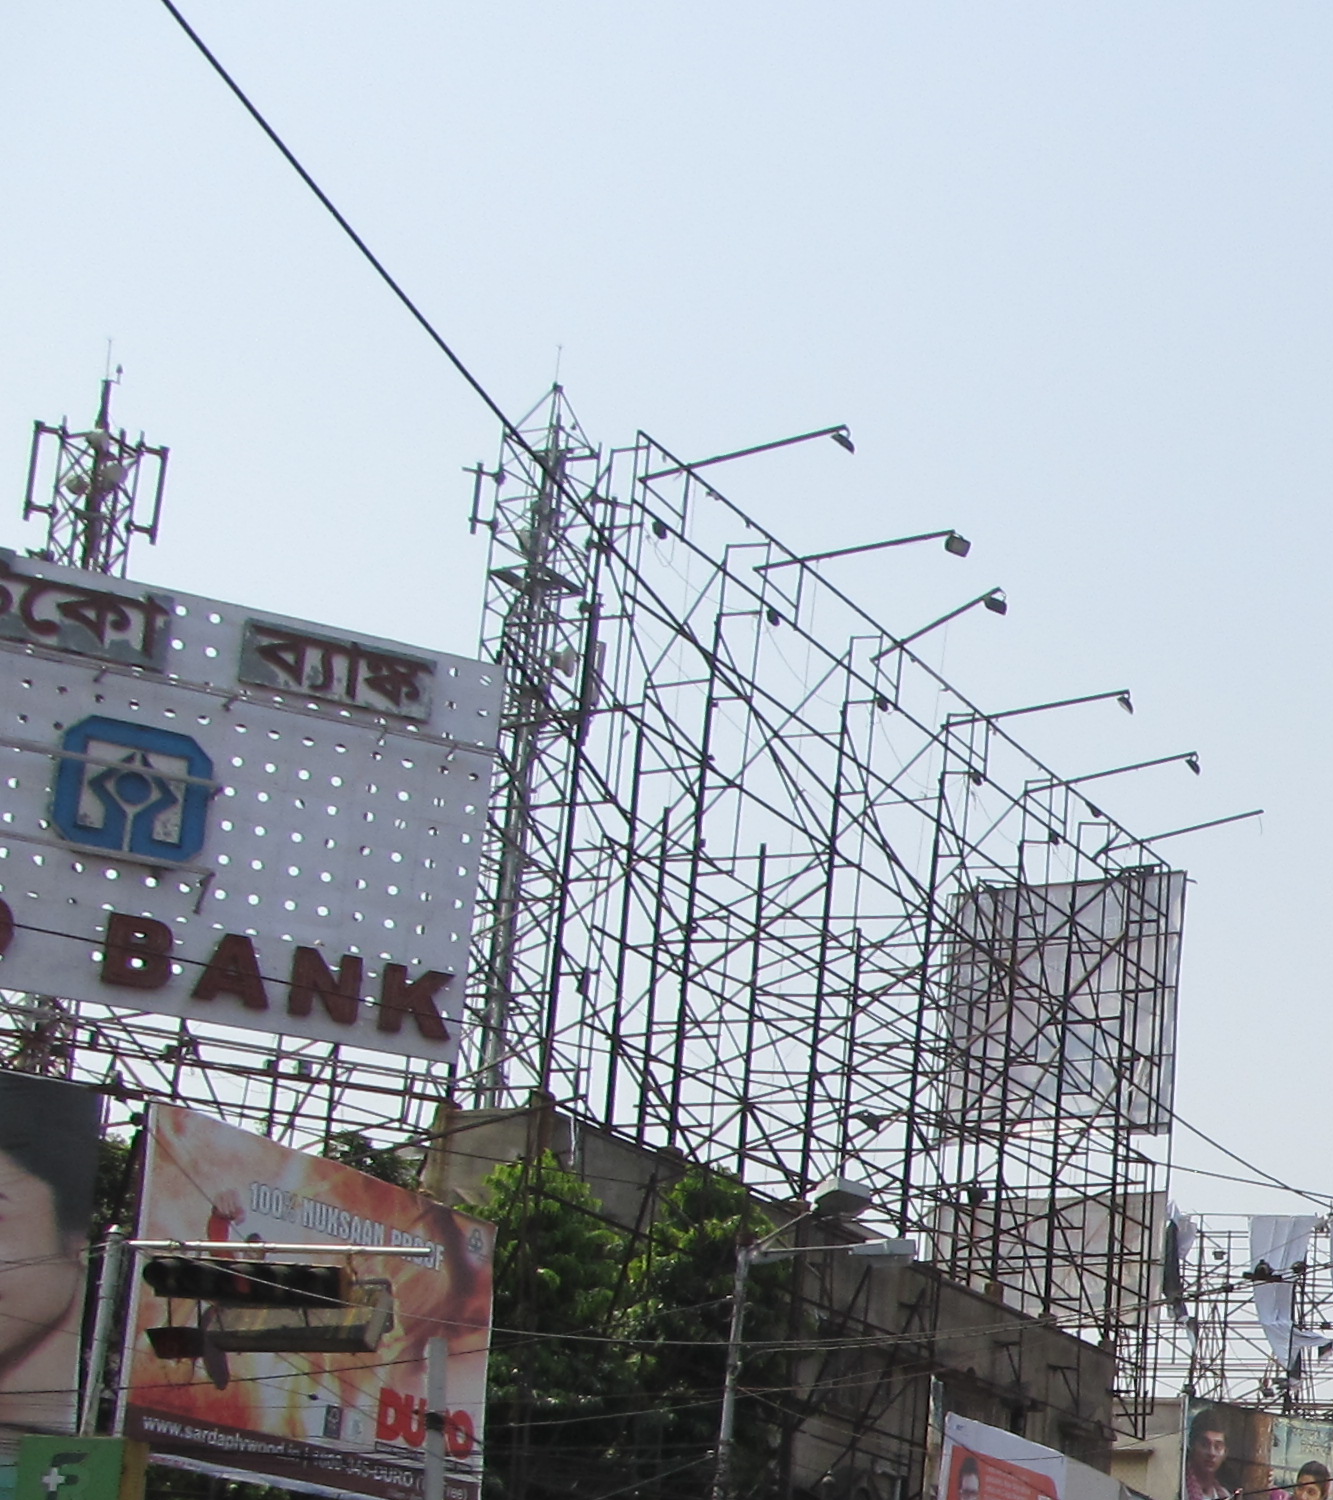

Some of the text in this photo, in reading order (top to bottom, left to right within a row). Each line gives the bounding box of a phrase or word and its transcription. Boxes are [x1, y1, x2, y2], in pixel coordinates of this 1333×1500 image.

[100, 911, 455, 1042] BANK
[303, 1196, 385, 1246] NUKSAAN
[375, 1387, 474, 1460] DUO
